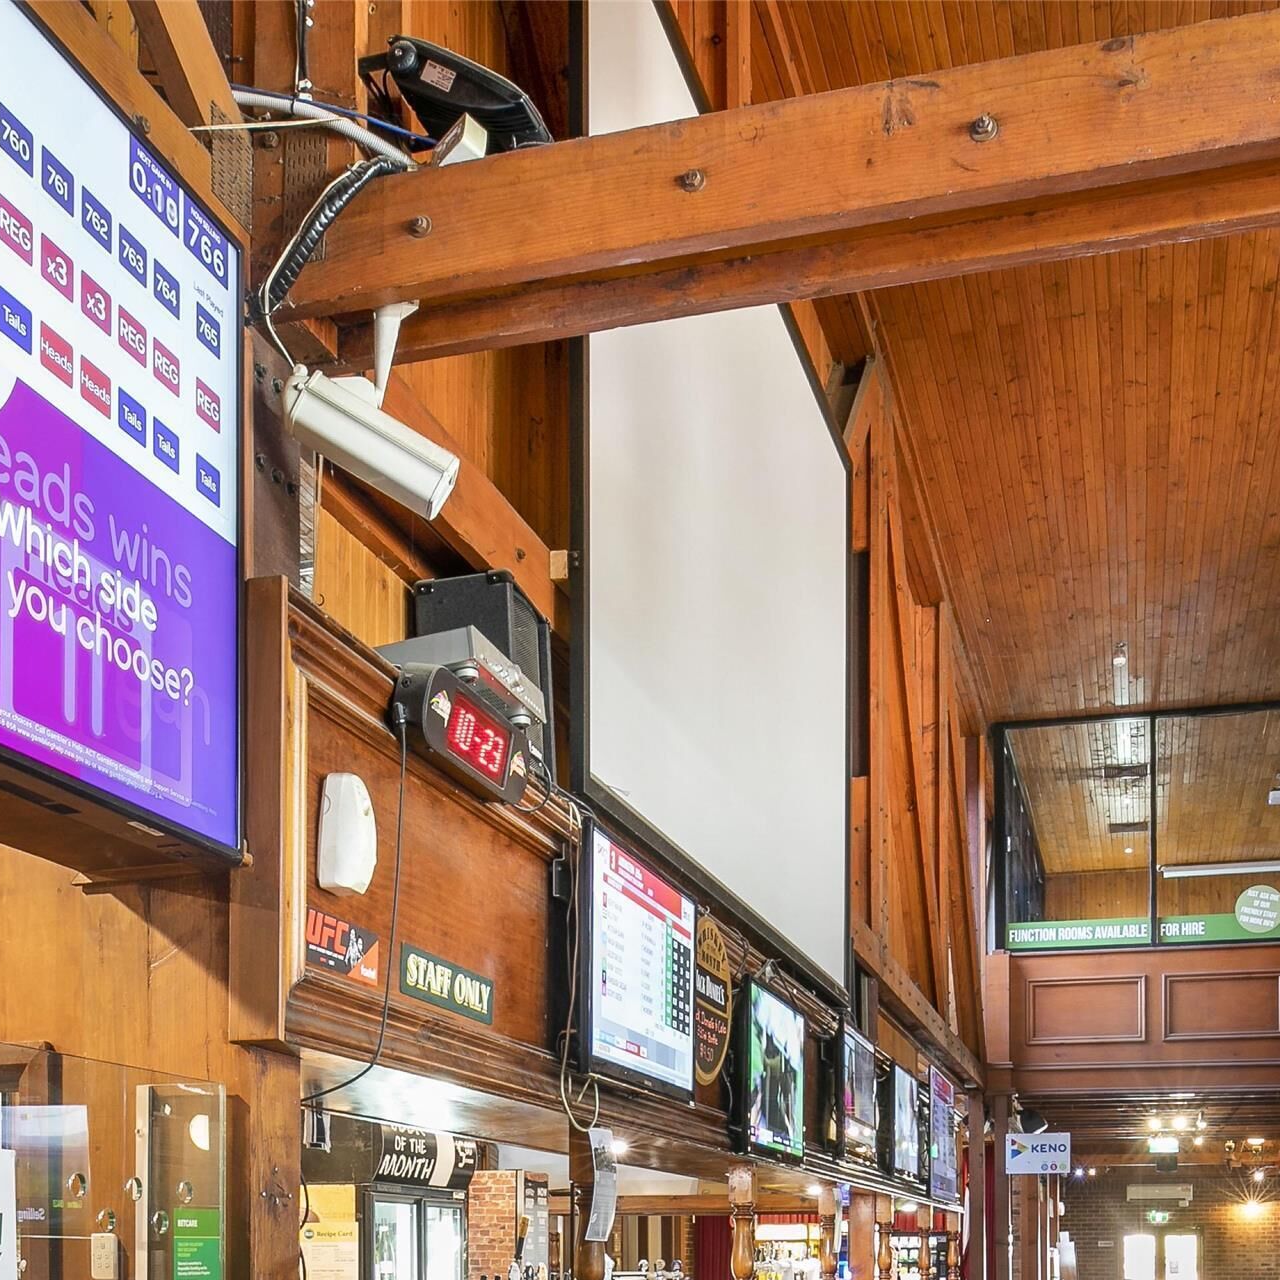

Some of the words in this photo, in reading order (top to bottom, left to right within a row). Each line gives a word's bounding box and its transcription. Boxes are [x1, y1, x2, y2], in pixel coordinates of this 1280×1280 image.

[0, 203, 32, 252] REG
[1, 119, 30, 161] 760
[46, 163, 70, 199] 761
[84, 202, 109, 241] 762
[121, 239, 145, 276] 763
[155, 272, 178, 308] 764
[187, 218, 225, 280] 766
[198, 313, 219, 347] 765
[40, 335, 73, 375] Heads
[99, 569, 158, 632] side
[6, 569, 66, 636] you
[76, 607, 195, 706] choose?
[306, 908, 350, 955] UFC
[1009, 928, 1056, 943] FUNCTION
[1057, 926, 1093, 941] ROOMS
[1094, 924, 1148, 939] AVAILABLE
[1160, 923, 1180, 936] FOR
[1181, 922, 1205, 936] HIRE
[406, 953, 453, 999] STAFF
[453, 973, 492, 1015] ONLY
[378, 1153, 435, 1180] MONTH
[394, 1135, 408, 1152] OF
[408, 1138, 427, 1155] THE
[1031, 1143, 1068, 1154] KENO
